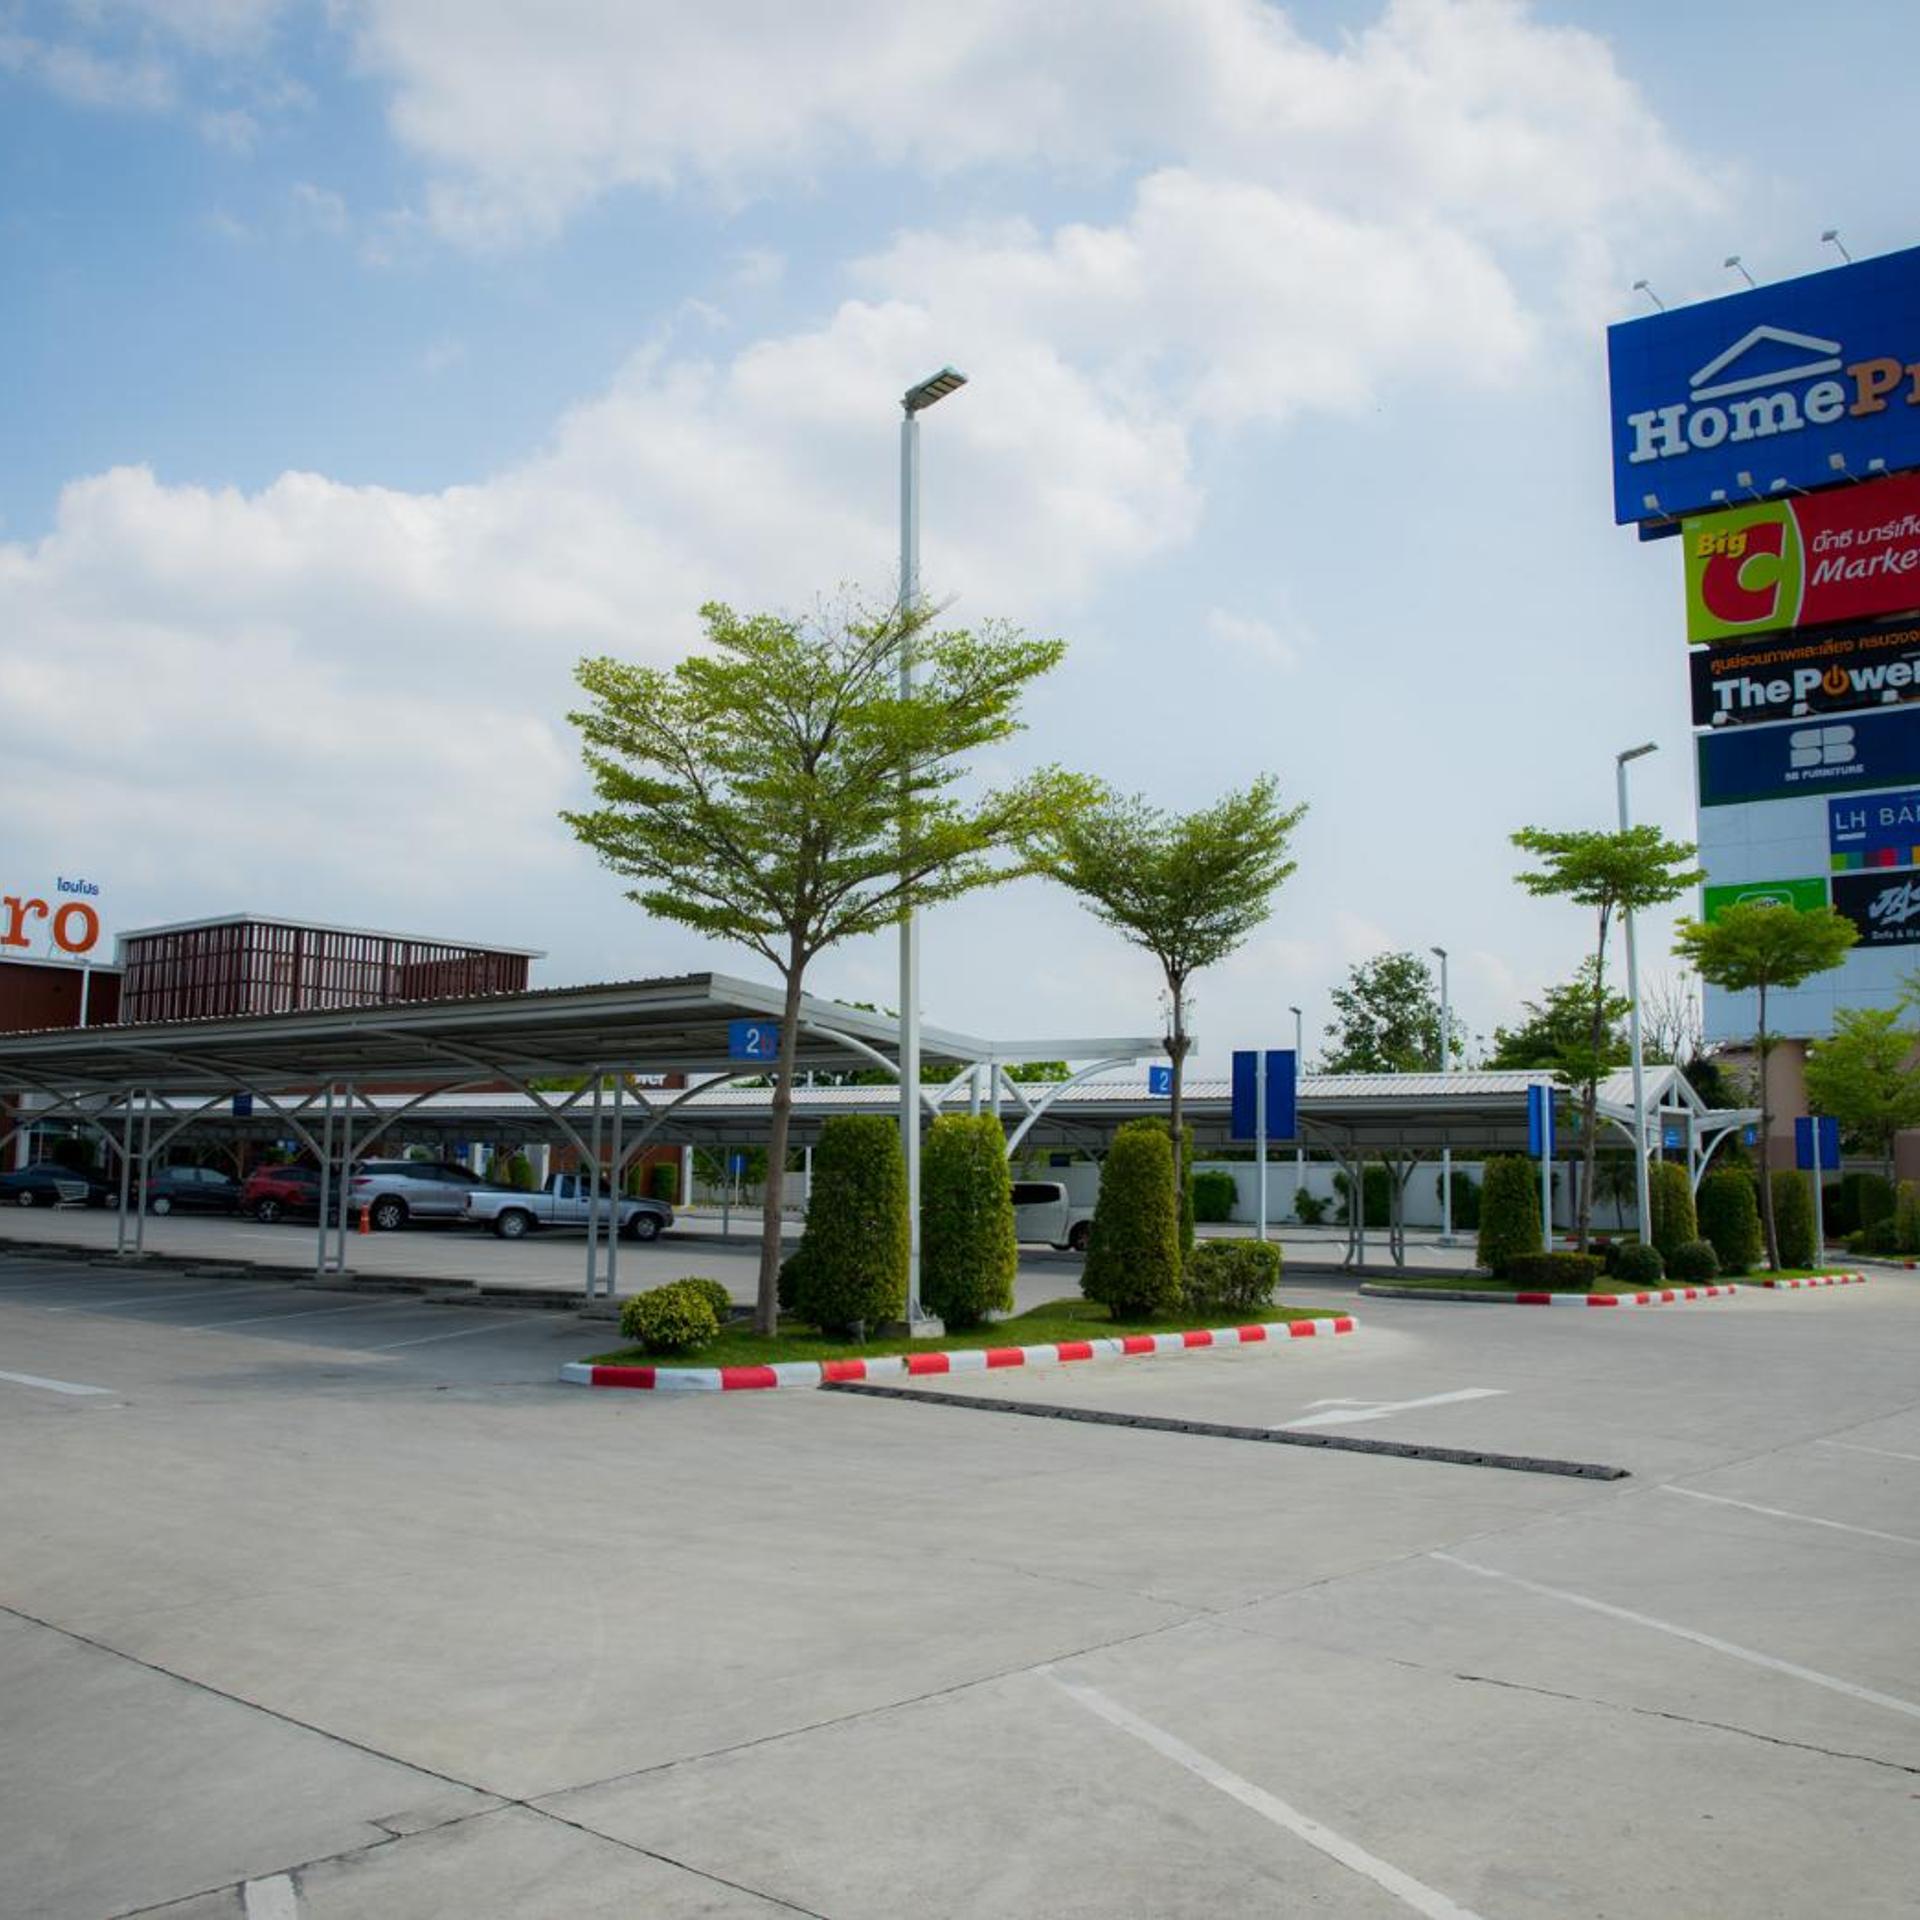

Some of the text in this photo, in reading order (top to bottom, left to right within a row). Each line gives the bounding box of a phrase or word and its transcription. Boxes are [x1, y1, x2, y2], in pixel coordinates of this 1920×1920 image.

[1697, 520, 1787, 625] Big C
[1811, 546, 1920, 587] Marke
[1789, 724, 1856, 768] SB
[1835, 804, 1920, 830] LH BA
